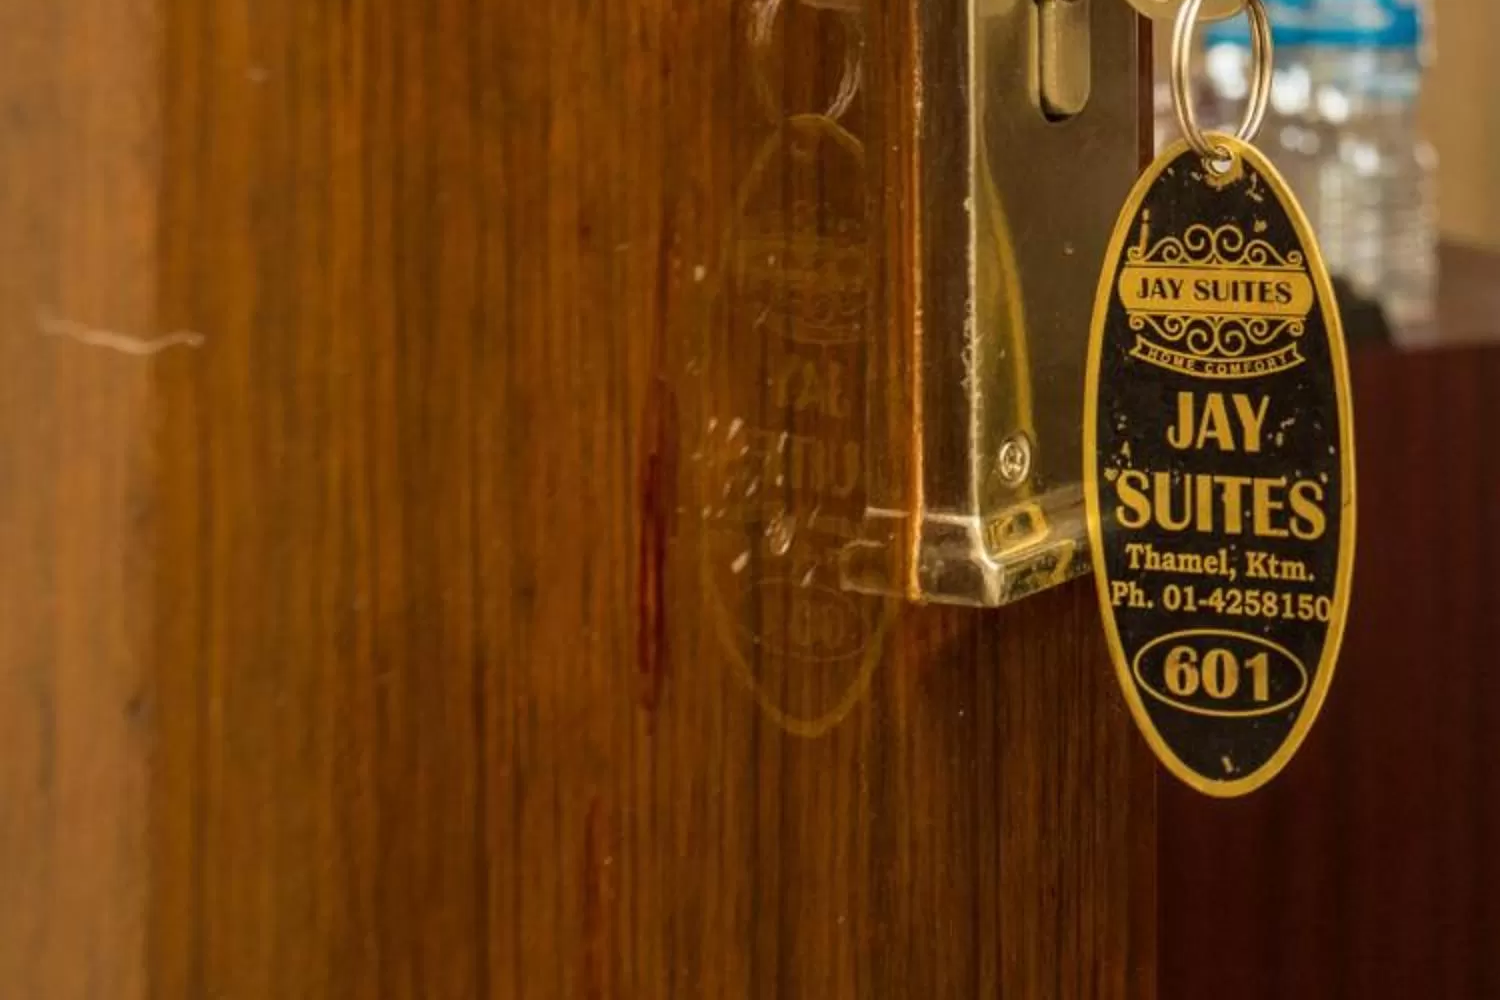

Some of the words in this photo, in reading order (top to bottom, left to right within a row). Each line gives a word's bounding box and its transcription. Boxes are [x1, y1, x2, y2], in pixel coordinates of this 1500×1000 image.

[1136, 278, 1185, 299] JAY
[1193, 279, 1293, 303] SUITES
[1148, 347, 1196, 371] HOME
[1167, 391, 1269, 452] JAY
[1115, 470, 1326, 540] SUITES
[1125, 544, 1237, 581] Thamel,
[1245, 551, 1315, 582] Ktm.
[1111, 581, 1153, 609] Ph.
[1163, 585, 1331, 622] 01-4258150
[1164, 646, 1269, 701] 601
